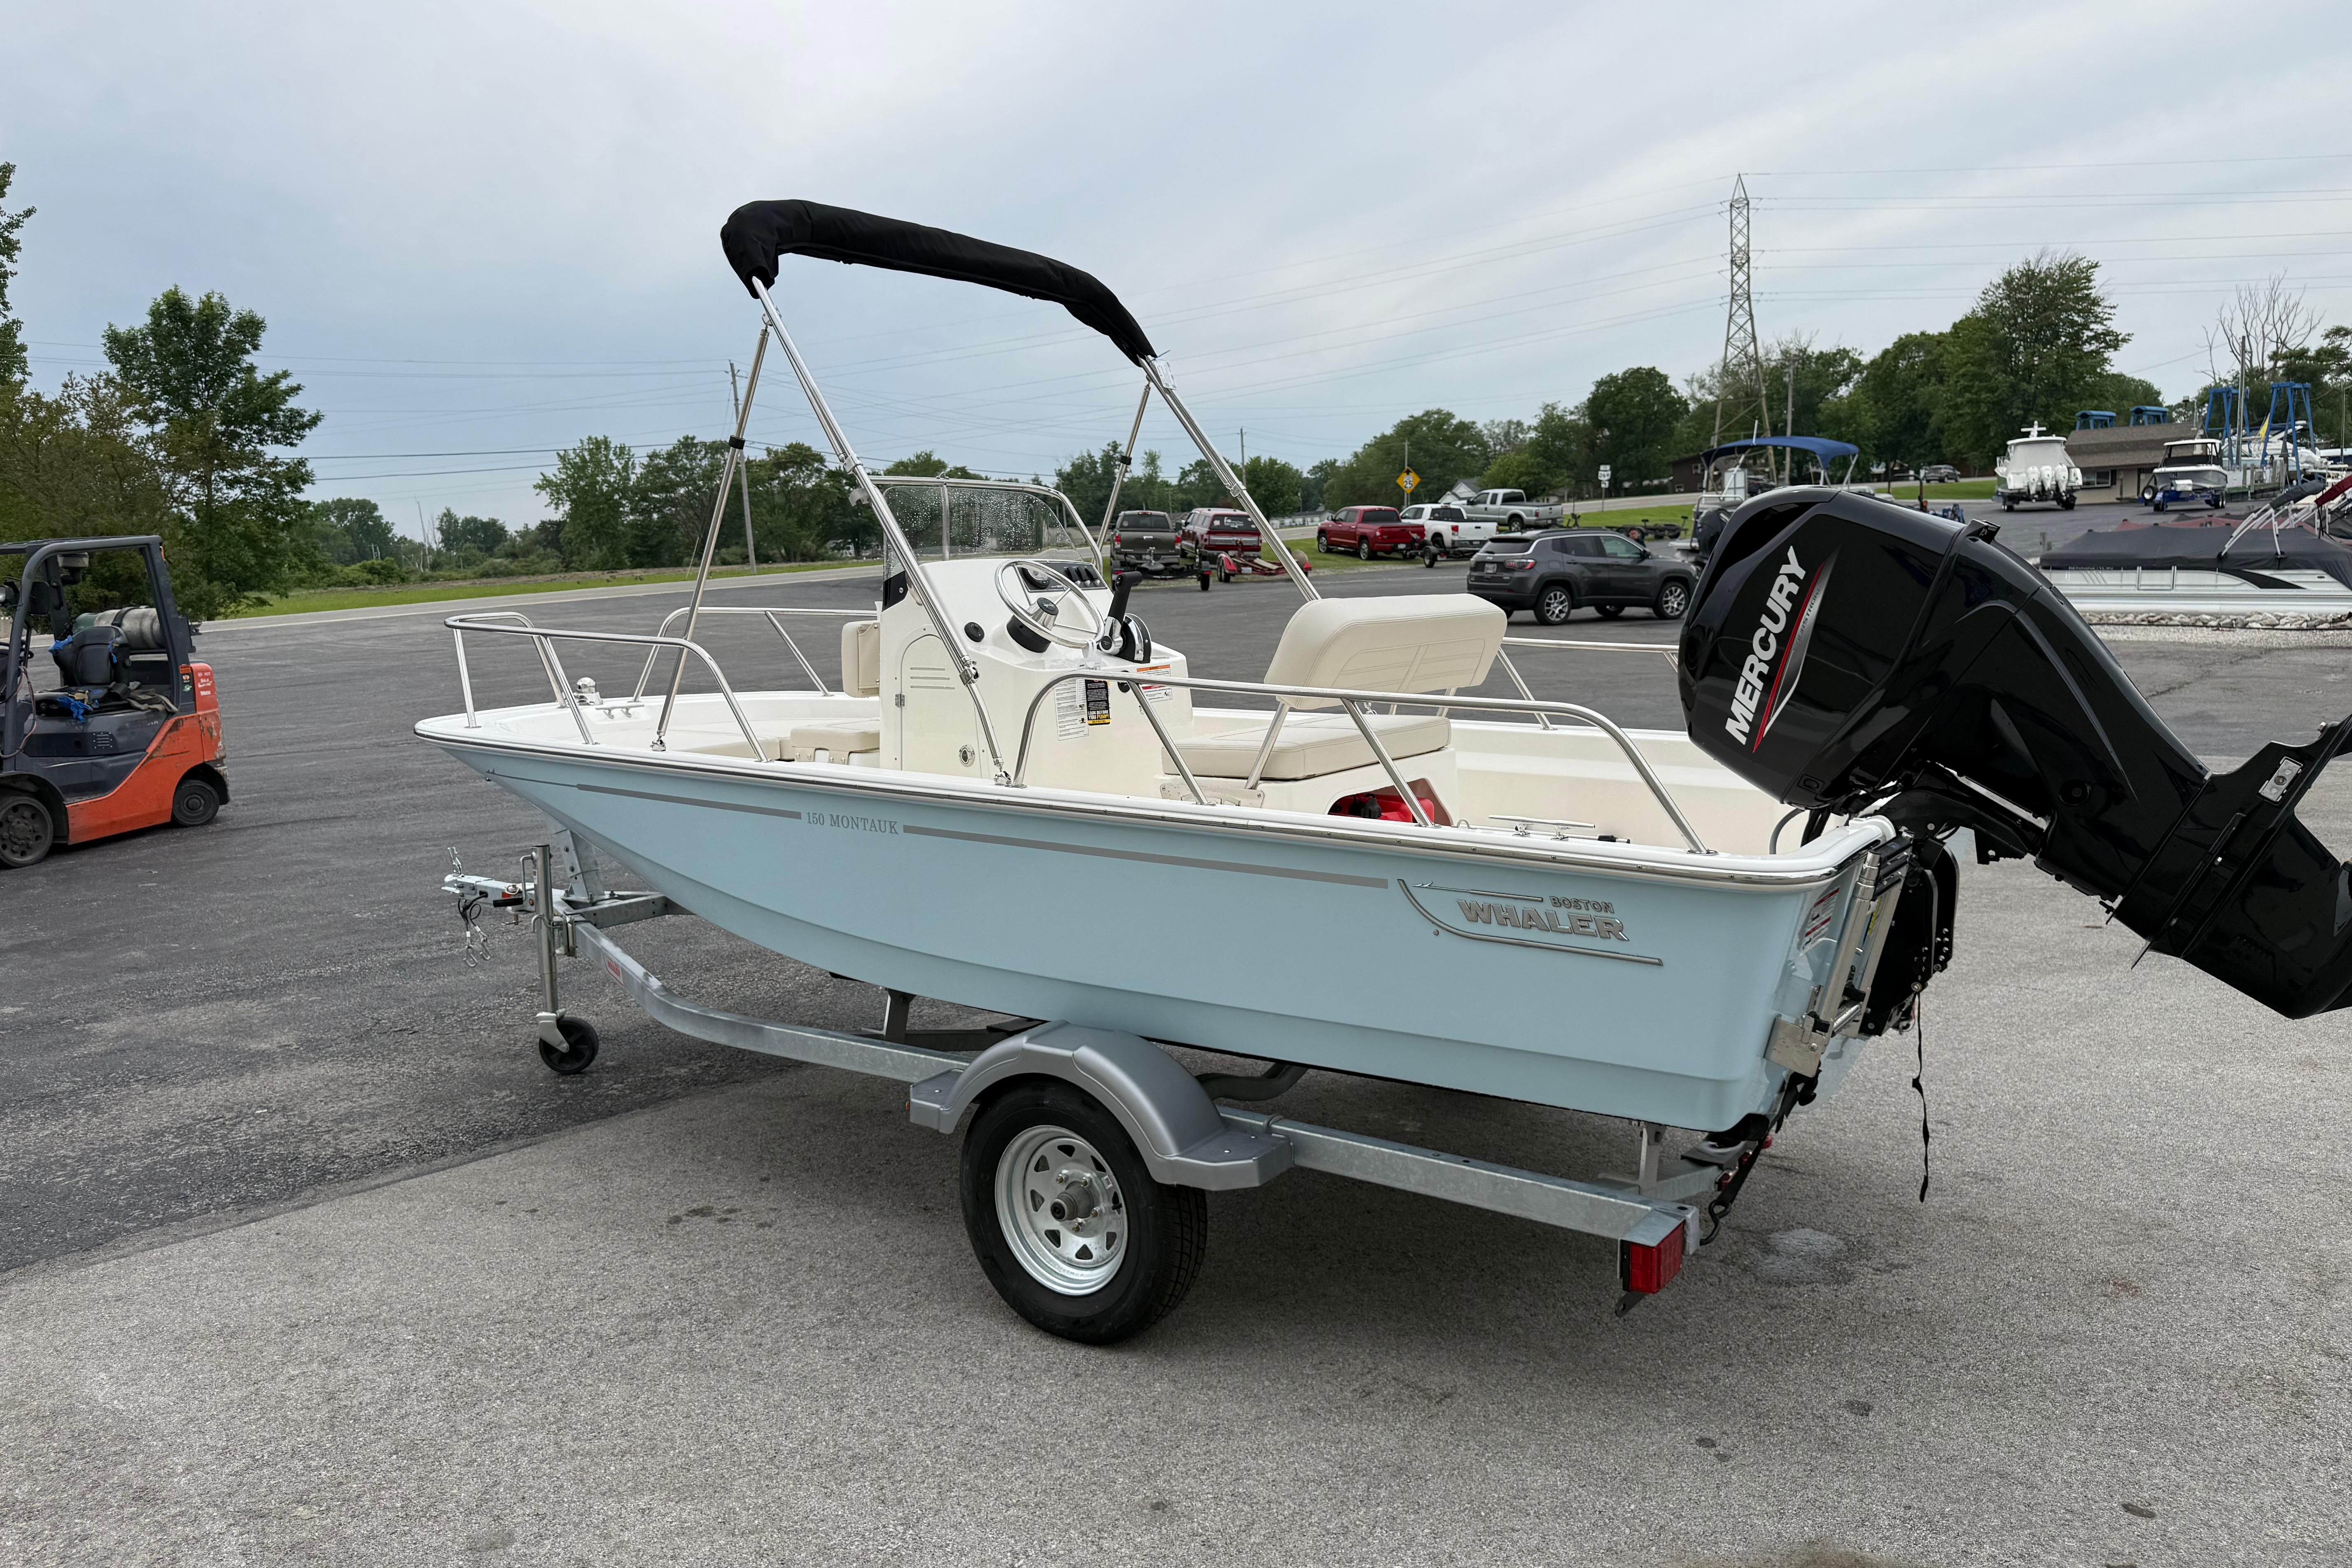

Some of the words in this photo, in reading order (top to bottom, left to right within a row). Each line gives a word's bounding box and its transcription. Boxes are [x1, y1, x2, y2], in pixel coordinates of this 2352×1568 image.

[1725, 545, 1806, 745] MERCURY
[806, 812, 824, 825] 150
[829, 814, 899, 835] MONTAUK
[1456, 898, 1629, 941] WHALER
[1549, 896, 1614, 914] BOSTON
